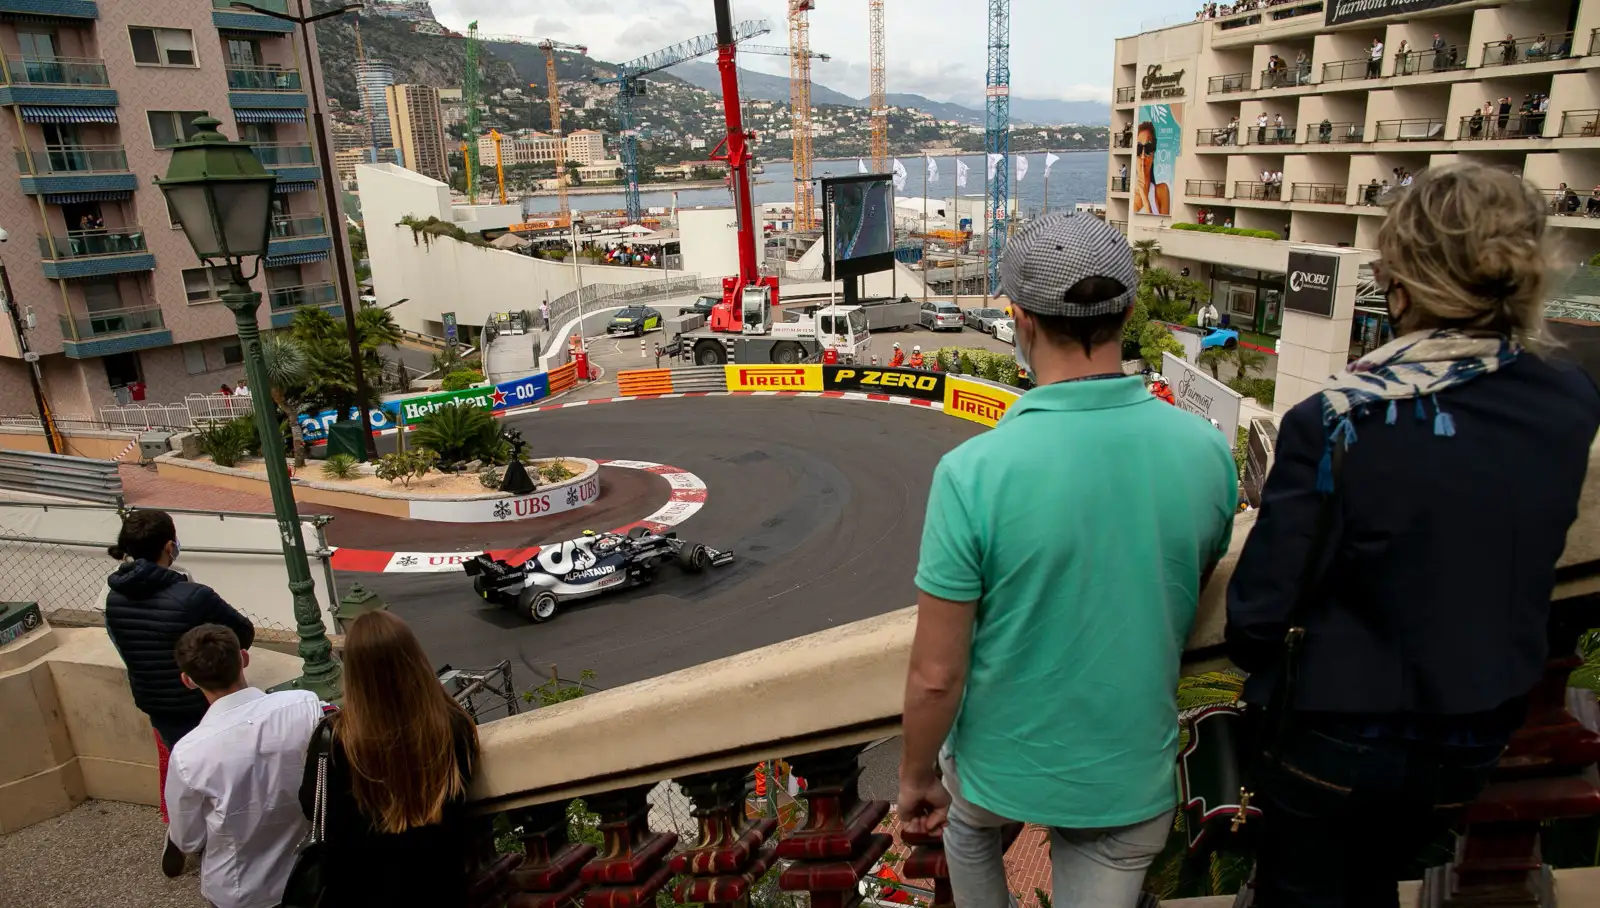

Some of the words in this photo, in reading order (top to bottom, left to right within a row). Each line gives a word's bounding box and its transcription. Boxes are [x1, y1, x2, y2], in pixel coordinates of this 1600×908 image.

[1142, 64, 1185, 90] Fairmont
[1300, 271, 1330, 285] NOBU
[739, 368, 806, 386] PIRELLI
[834, 370, 856, 383] P
[860, 371, 938, 391] ZERO
[1178, 368, 1214, 415] Fairmont
[579, 480, 597, 502] UBS
[514, 495, 551, 517] UBS
[564, 565, 616, 582] ALPHATAURI
